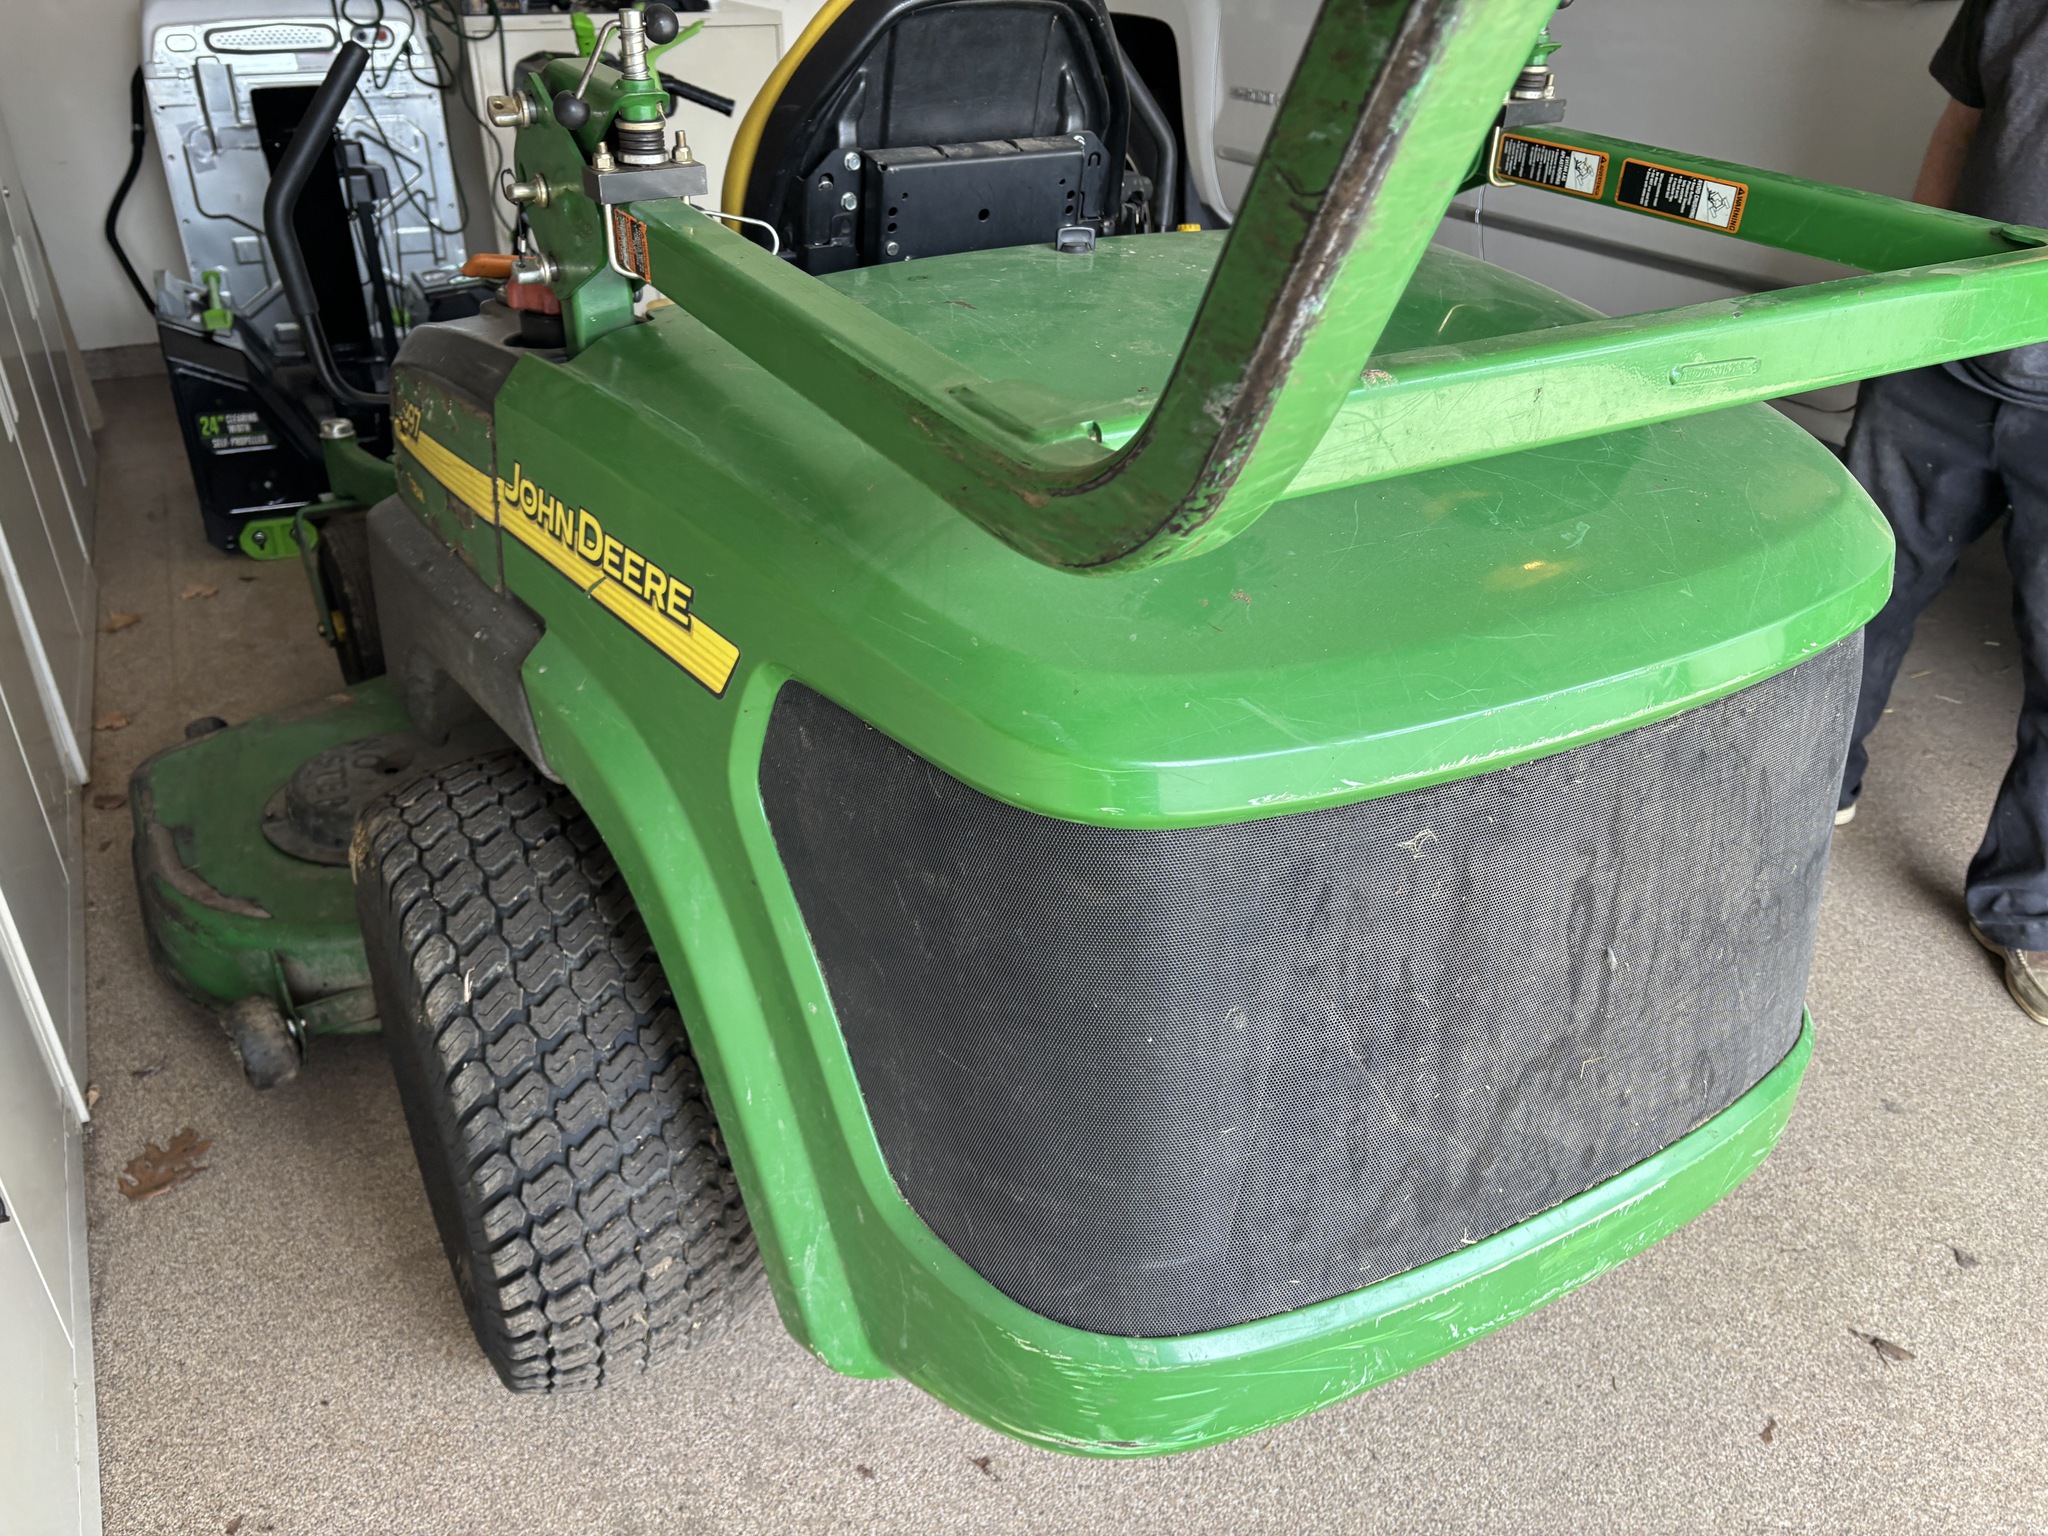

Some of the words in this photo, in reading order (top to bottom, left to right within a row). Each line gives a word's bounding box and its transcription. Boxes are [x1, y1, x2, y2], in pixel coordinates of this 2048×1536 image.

[1728, 195, 1743, 232] WARNING
[504, 461, 575, 547] JOHN
[576, 507, 694, 632] DEERE
